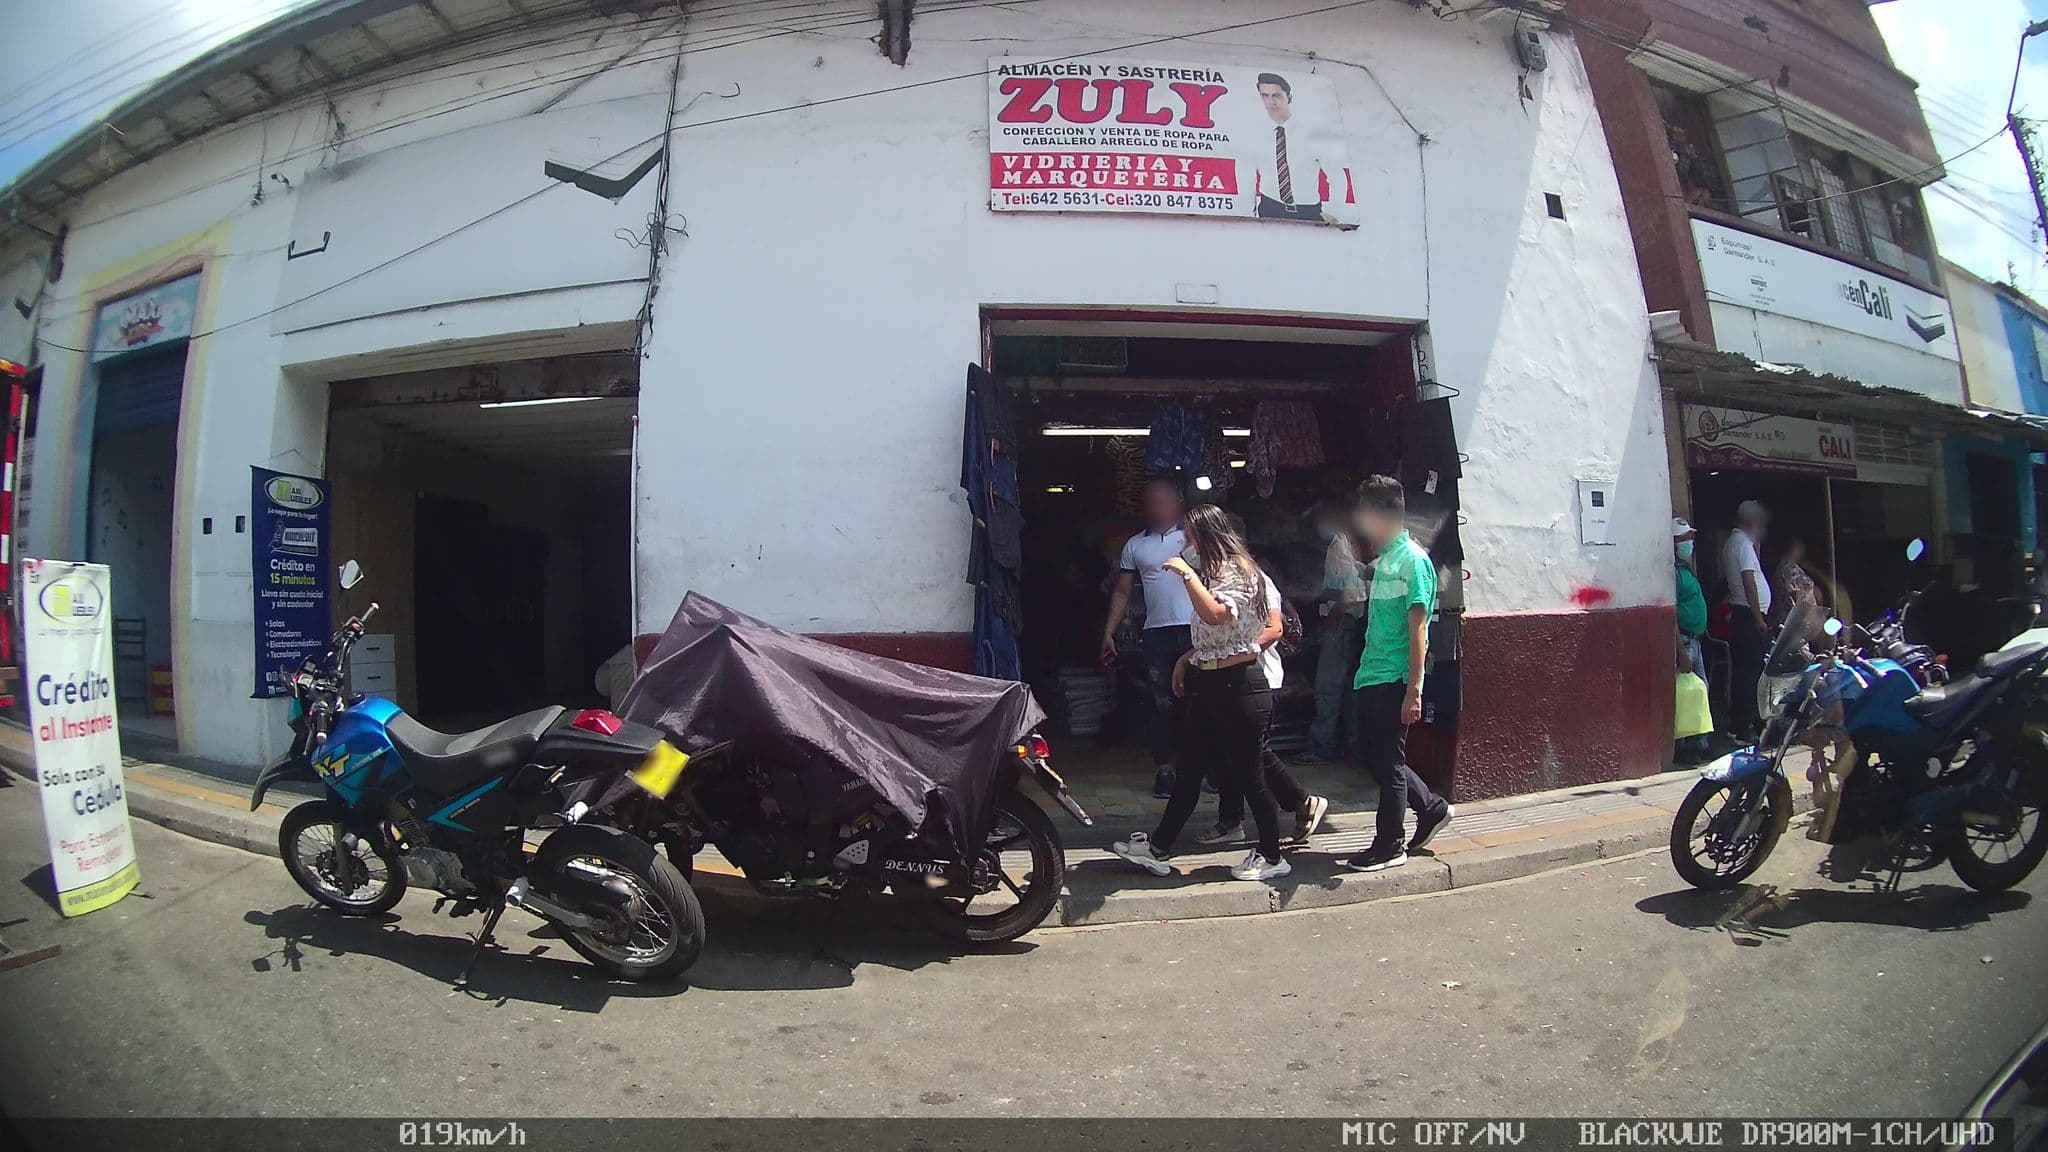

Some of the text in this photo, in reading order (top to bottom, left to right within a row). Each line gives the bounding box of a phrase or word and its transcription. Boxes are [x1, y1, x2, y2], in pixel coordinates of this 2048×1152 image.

[998, 62, 1225, 83] ALMACÉN Y SASTRERÍA
[997, 77, 1228, 128] ZULY
[1003, 126, 1230, 142] CONFECCIÓN Y VENTA DE ROPA PARA
[1022, 137, 1213, 150] CABALLERO ARREGLO DE ROPA
[1002, 155, 1193, 172] VIDRIERIA Y
[1001, 170, 1225, 189] MARQUETERÍA
[1002, 191, 1058, 205] Tel:642
[1166, 195, 1192, 208] 847
[1198, 196, 1233, 210] 8375
[1819, 435, 1852, 459] CALI
[270, 559, 315, 571] Crédito en
[271, 573, 316, 585] 15 minutos
[271, 601, 276, 609] y
[37, 672, 110, 706] Crédito
[40, 714, 113, 742] al Instante
[74, 768, 95, 782] con
[312, 753, 351, 779] XT
[73, 778, 122, 815] Cédula
